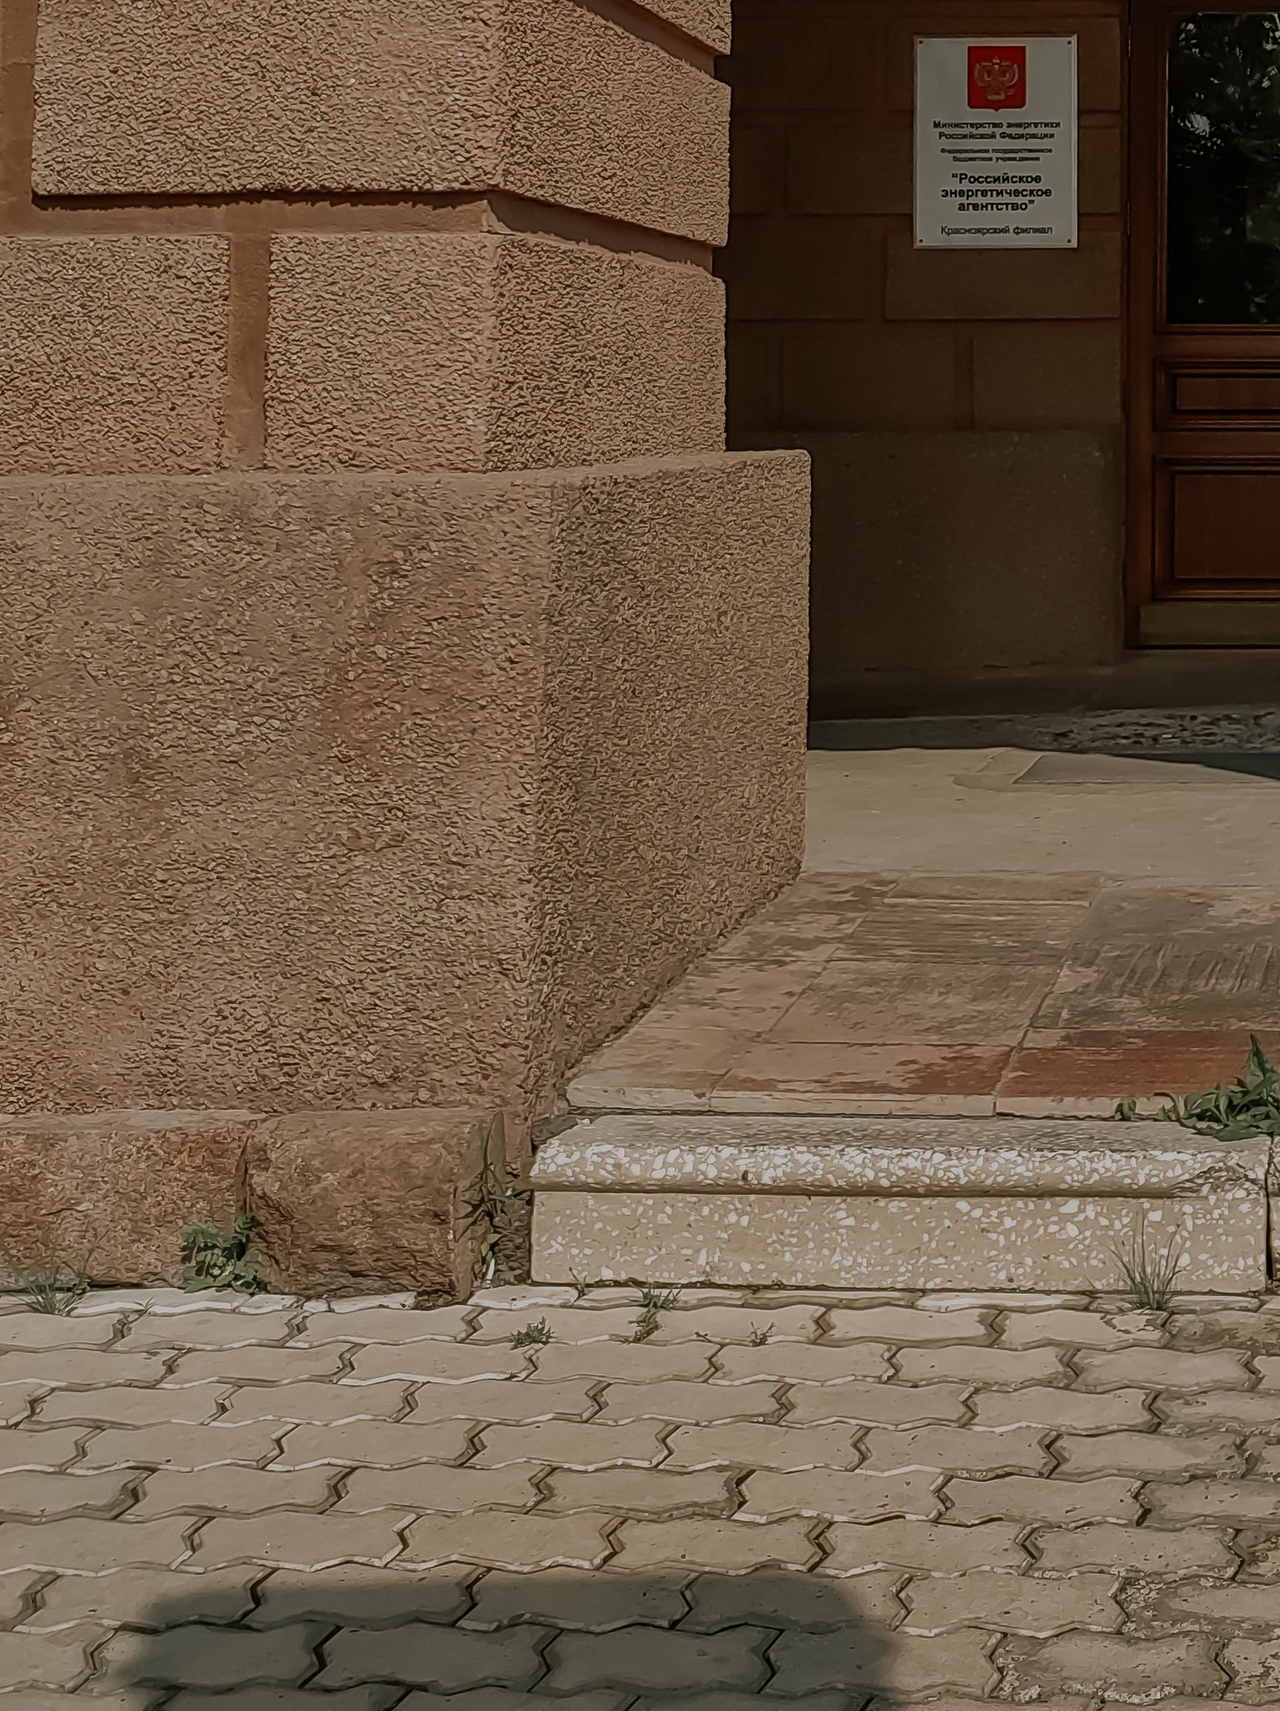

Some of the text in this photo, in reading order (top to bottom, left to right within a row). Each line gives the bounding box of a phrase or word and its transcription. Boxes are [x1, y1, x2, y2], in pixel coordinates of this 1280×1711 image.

[932, 120, 1004, 130] Министерство
[940, 188, 1052, 200] энергетическое
[1013, 225, 1052, 236] филиал
